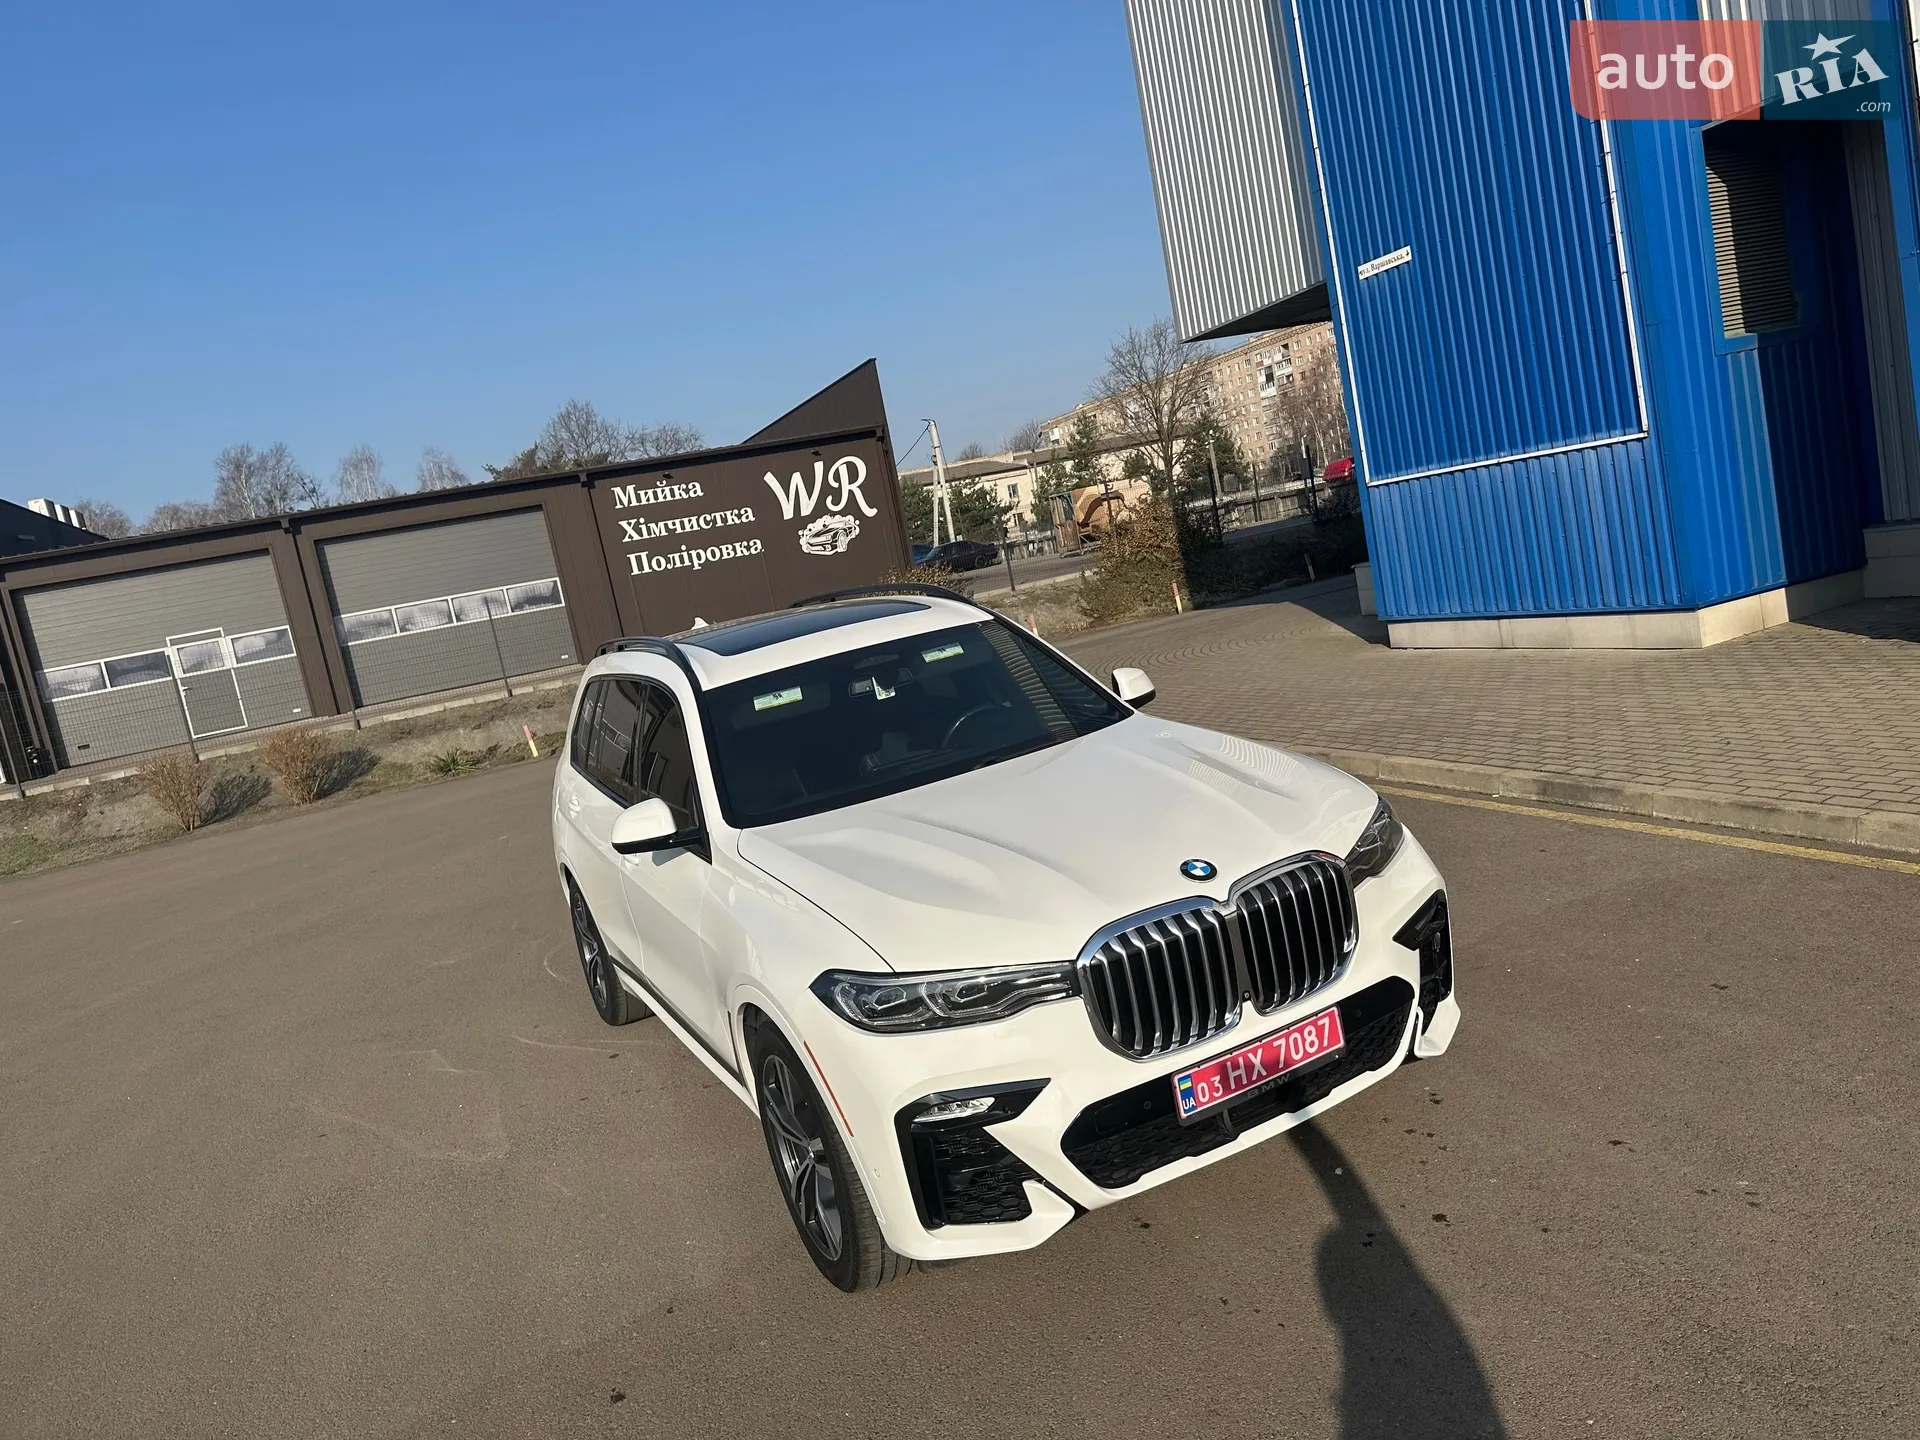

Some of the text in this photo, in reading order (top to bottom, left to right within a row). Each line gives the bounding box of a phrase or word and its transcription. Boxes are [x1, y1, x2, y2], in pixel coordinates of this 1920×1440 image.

[611, 479, 704, 509] Мийка
[763, 455, 878, 521] WR
[618, 505, 756, 543] Хімчистка
[627, 538, 764, 576] Поліровка
[1197, 1016, 1330, 1103] 03 HX 7087
[1182, 1098, 1196, 1111] UA
[1247, 1073, 1290, 1099] BMW
